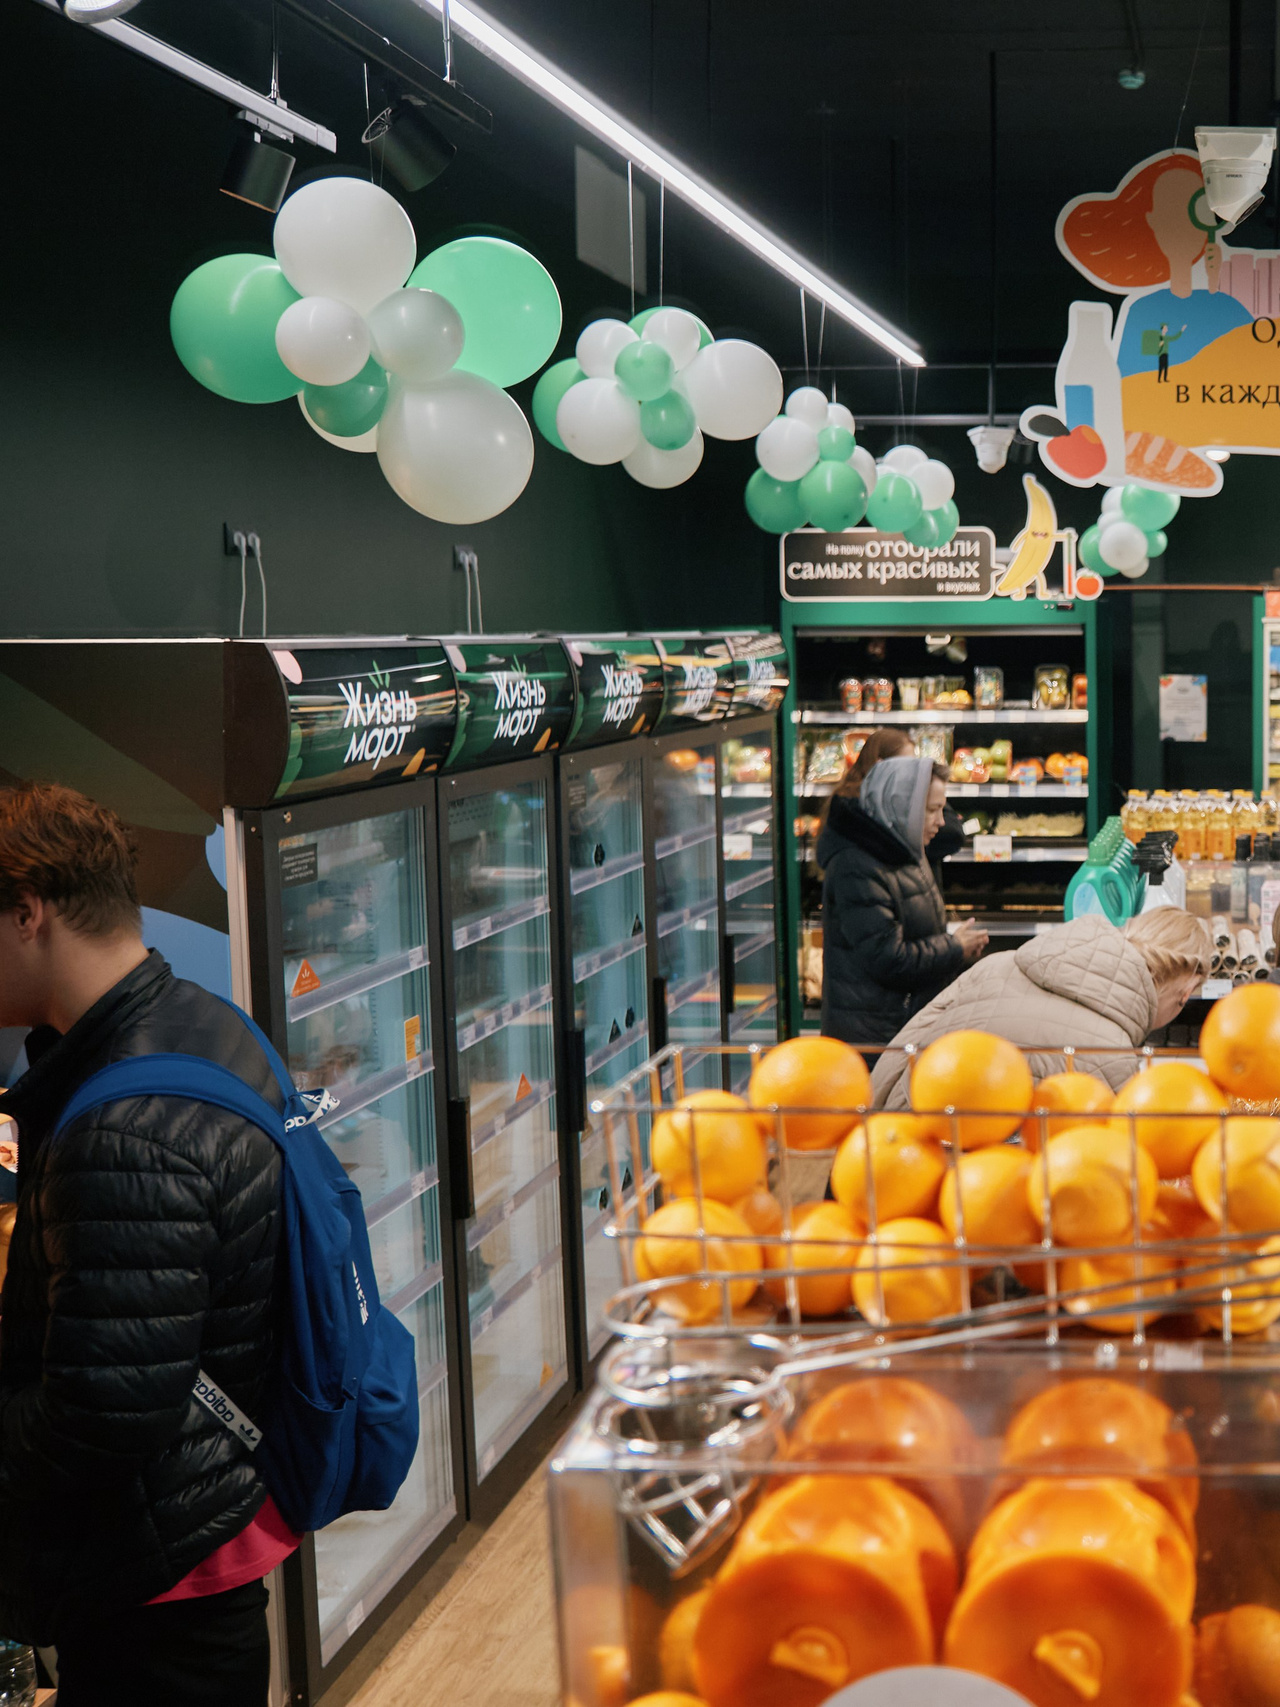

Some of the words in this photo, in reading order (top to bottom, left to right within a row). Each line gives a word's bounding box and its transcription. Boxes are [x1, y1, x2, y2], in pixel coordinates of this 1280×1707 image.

[1176, 384, 1190, 403] в
[825, 543, 840, 555] На
[841, 544, 864, 557] полку
[787, 561, 863, 580] самых
[867, 561, 980, 585] красивых
[937, 583, 943, 592] и
[944, 582, 980, 594] вкусных
[491, 672, 546, 710] Жизнь
[601, 664, 644, 698] Жизнь
[338, 681, 417, 728] Жизнь
[493, 707, 541, 746] март
[344, 724, 411, 770] март
